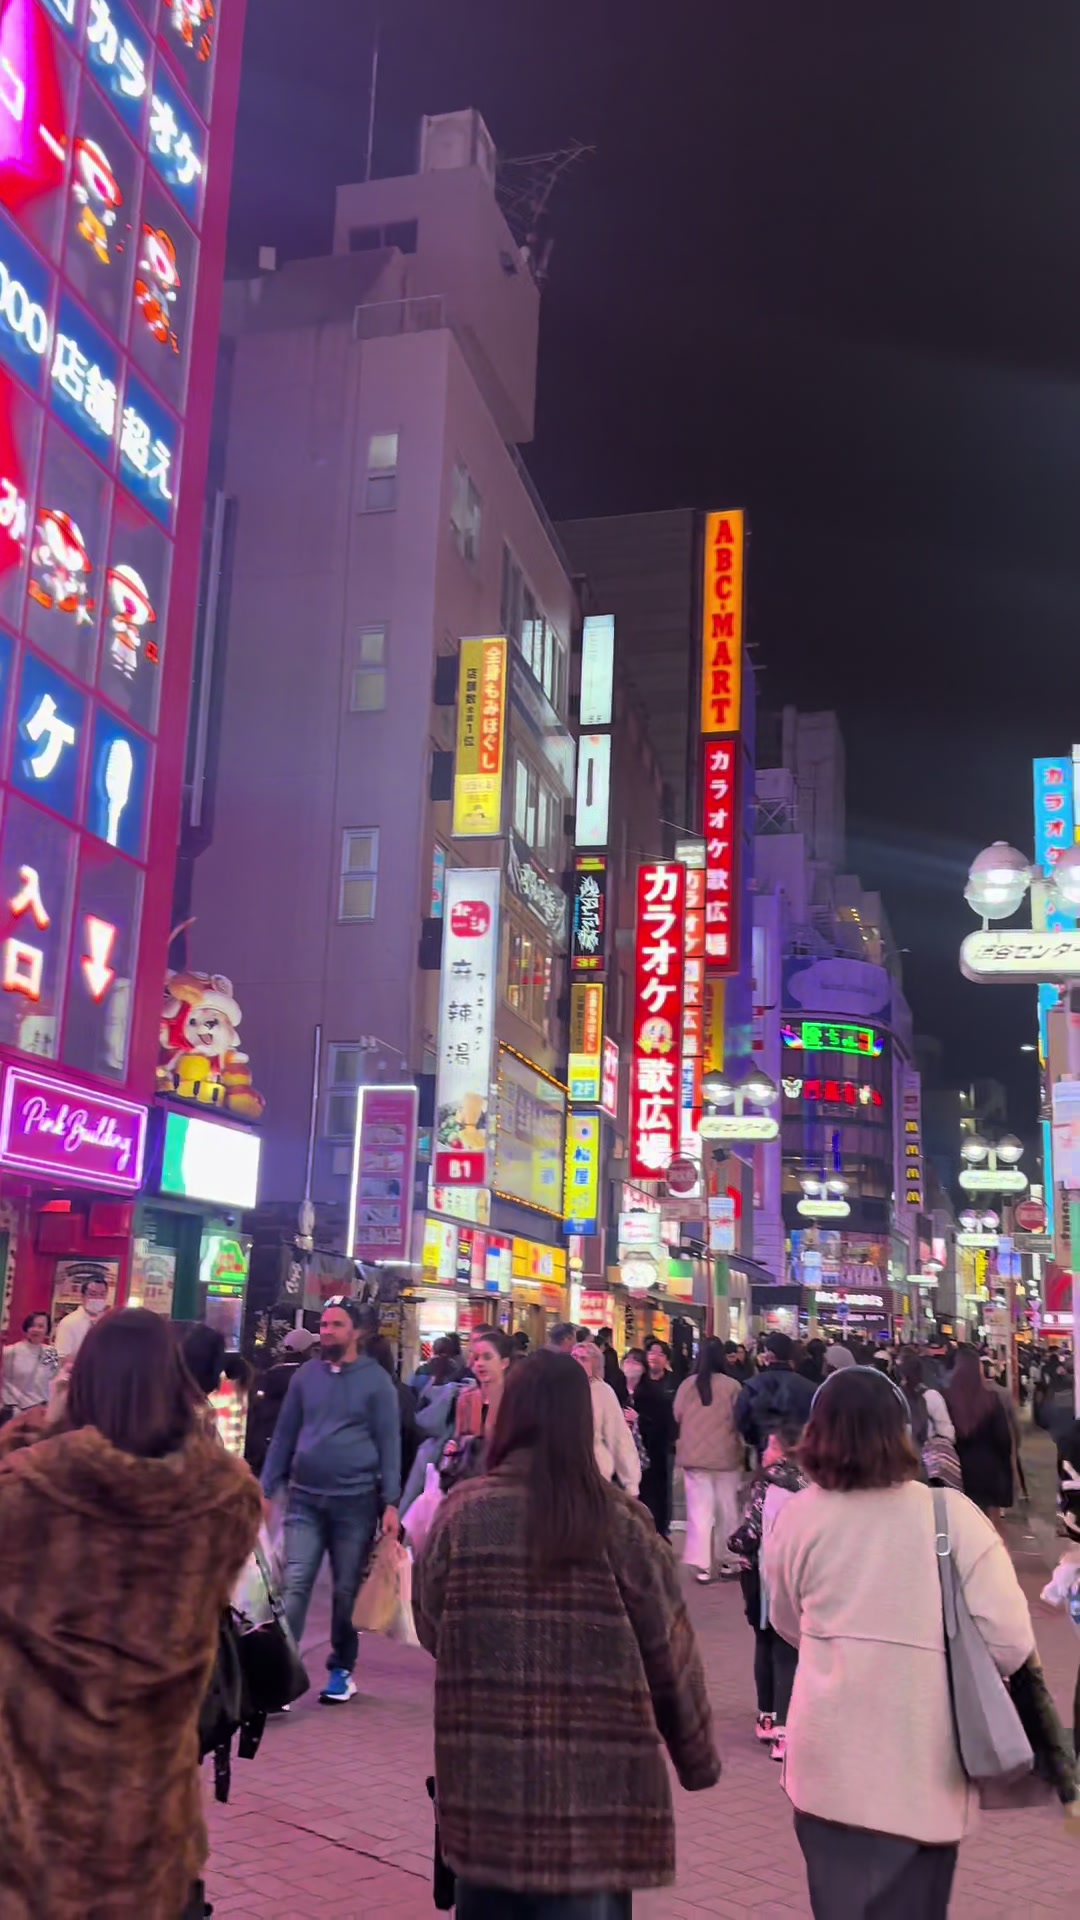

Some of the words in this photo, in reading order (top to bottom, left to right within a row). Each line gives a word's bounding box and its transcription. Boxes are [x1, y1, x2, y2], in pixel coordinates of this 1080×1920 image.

[3, 864, 50, 1002] 入口
[640, 866, 677, 1012] カラオケ
[22, 1096, 66, 1135] Pink
[66, 1109, 132, 1171] Building
[449, 1159, 471, 1178] B1
[636, 1057, 674, 1169] 歌広場
